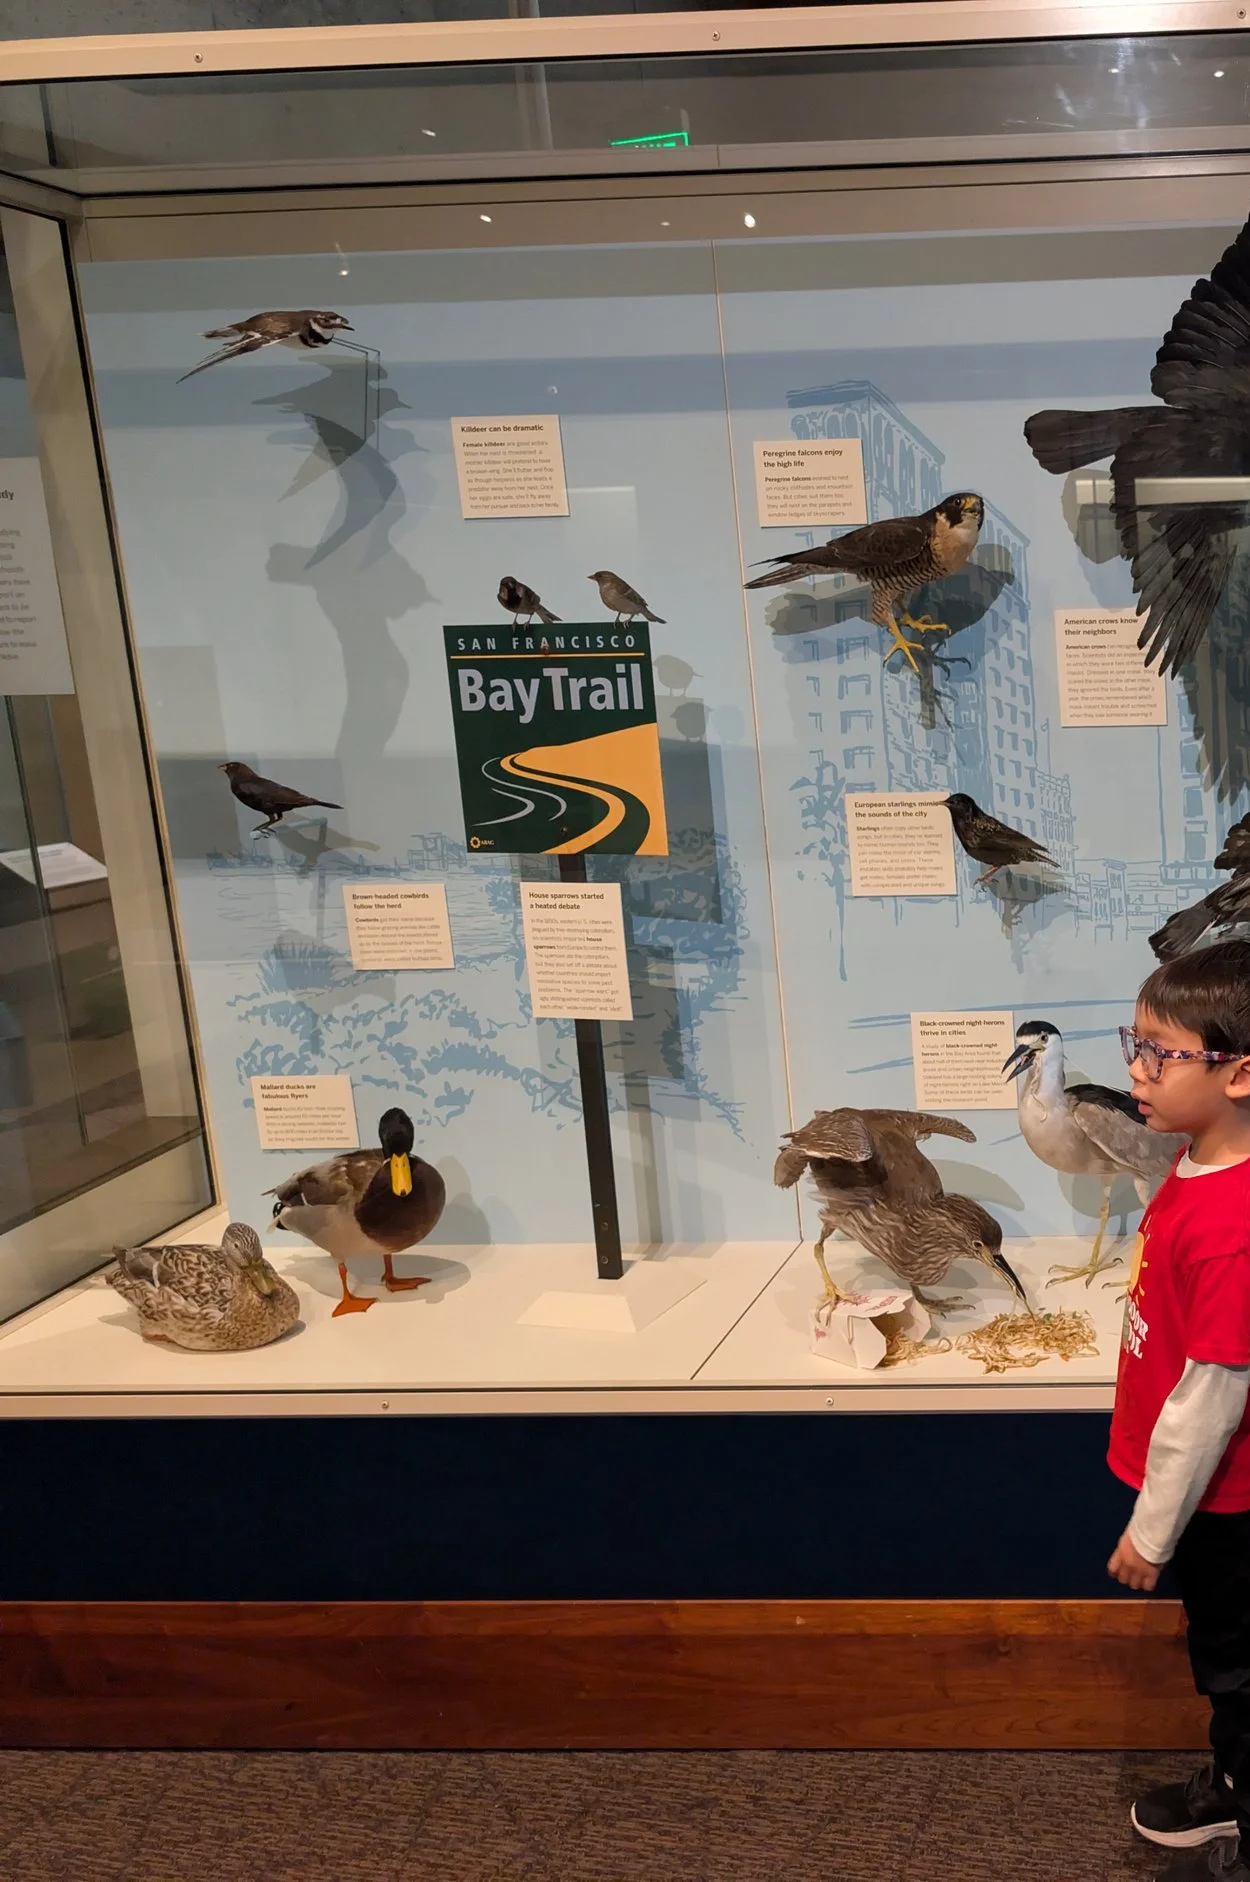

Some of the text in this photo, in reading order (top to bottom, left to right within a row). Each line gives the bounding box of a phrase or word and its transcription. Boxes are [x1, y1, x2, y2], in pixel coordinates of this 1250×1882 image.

[763, 450, 796, 458] Peregrine
[777, 460, 792, 468] high
[1083, 628, 1117, 636] neighbors
[458, 635, 635, 650] SAN FRANCISCO
